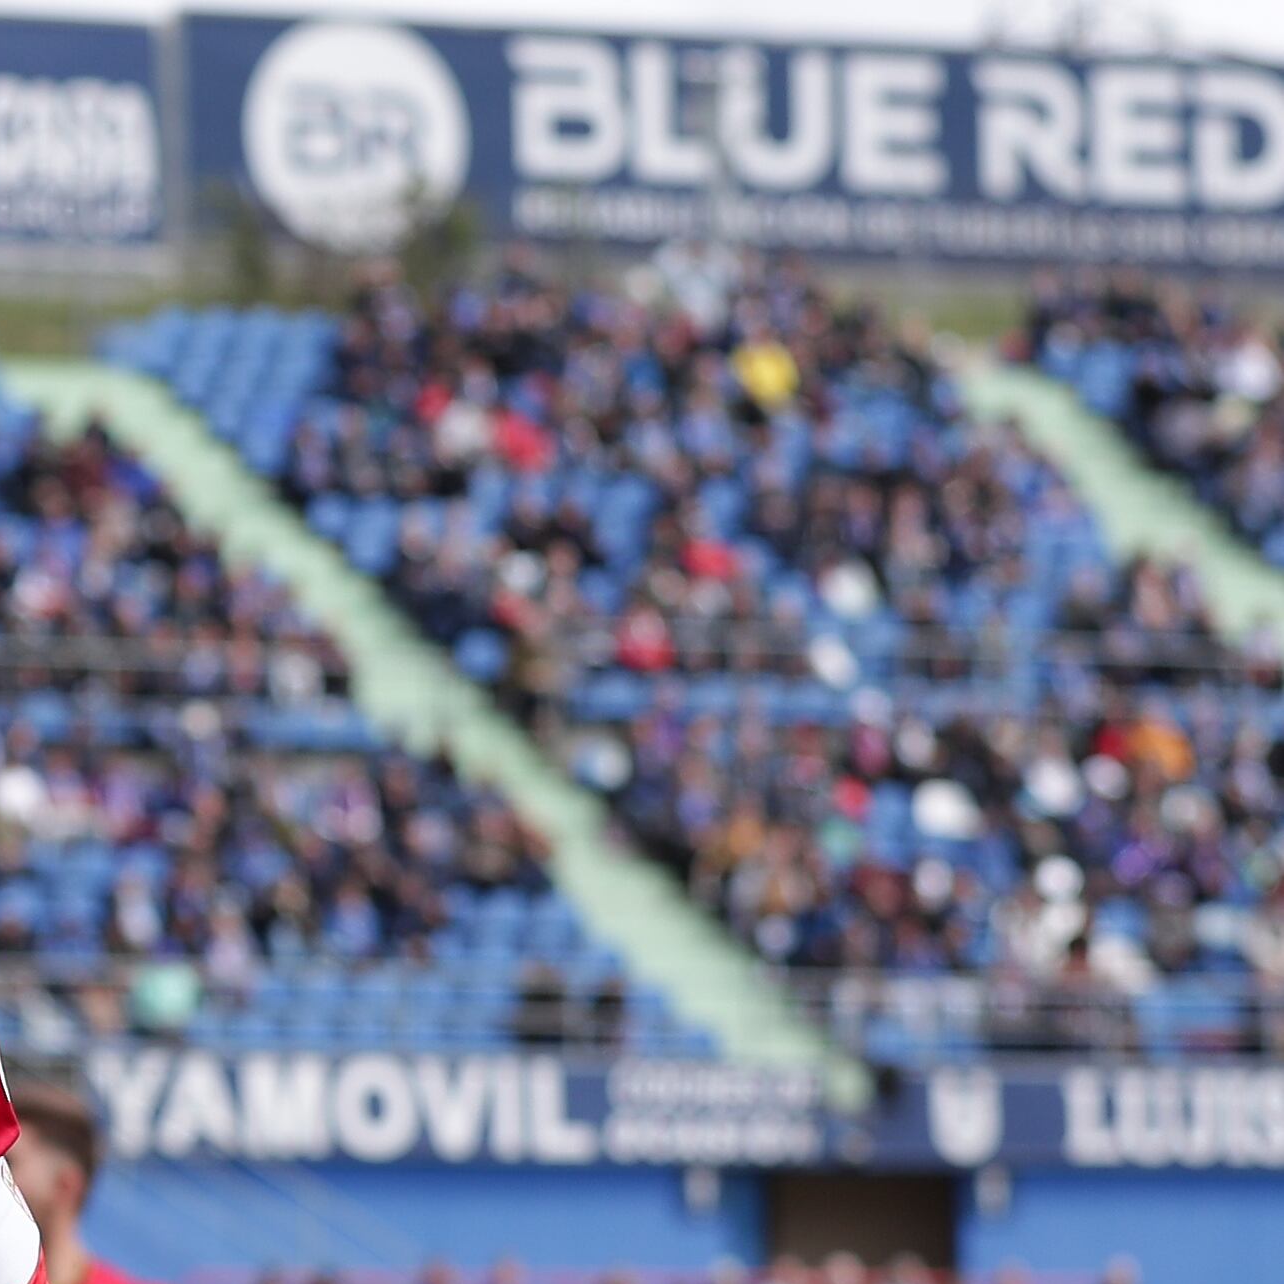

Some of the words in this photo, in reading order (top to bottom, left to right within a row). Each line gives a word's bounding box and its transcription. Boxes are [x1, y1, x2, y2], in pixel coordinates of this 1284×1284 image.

[505, 34, 951, 195] BLUE
[970, 56, 1284, 210] RED
[91, 1050, 596, 1164] YAMOVIL
